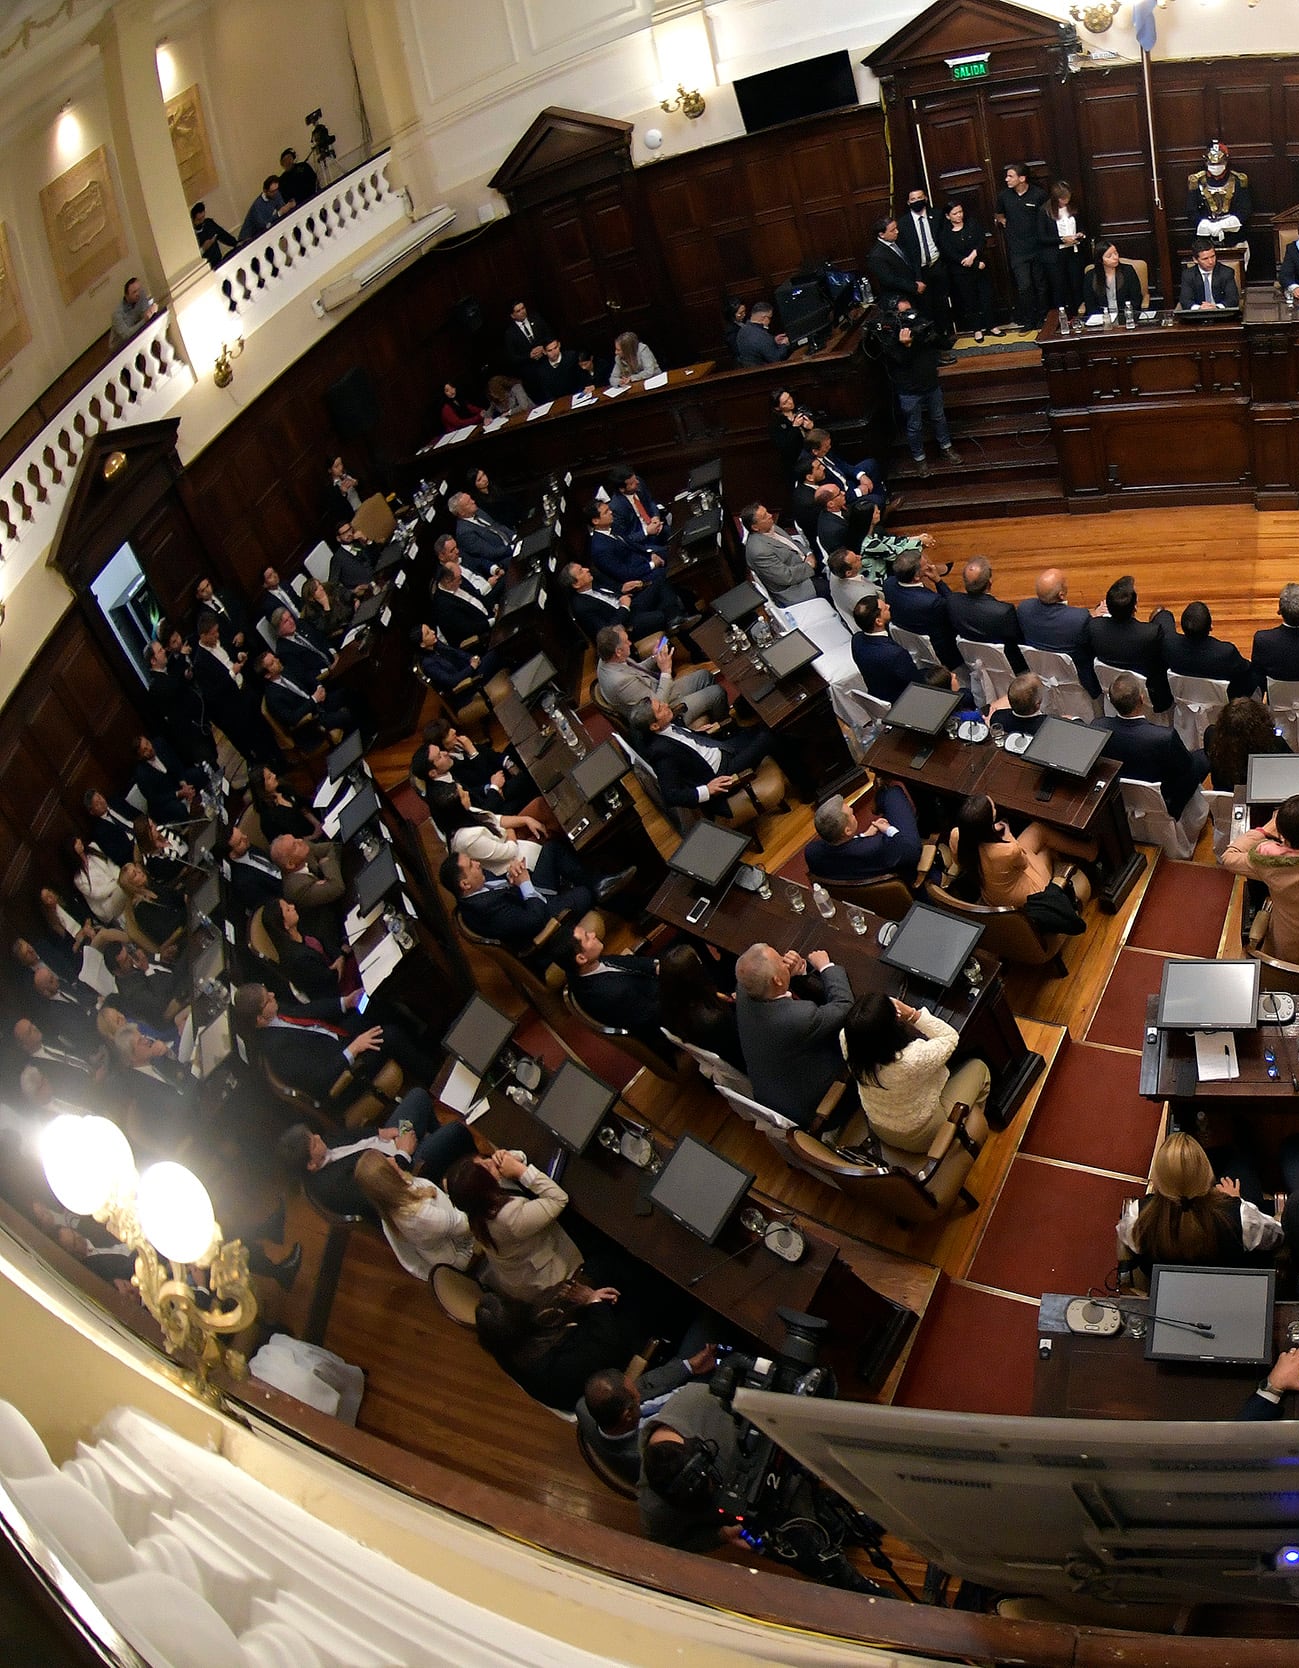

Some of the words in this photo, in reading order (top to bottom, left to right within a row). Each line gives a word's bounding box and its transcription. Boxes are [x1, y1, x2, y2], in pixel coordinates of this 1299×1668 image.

[954, 63, 986, 79] SALIDA
[876, 322, 882, 330] 3
[766, 1472, 781, 1490] 2
